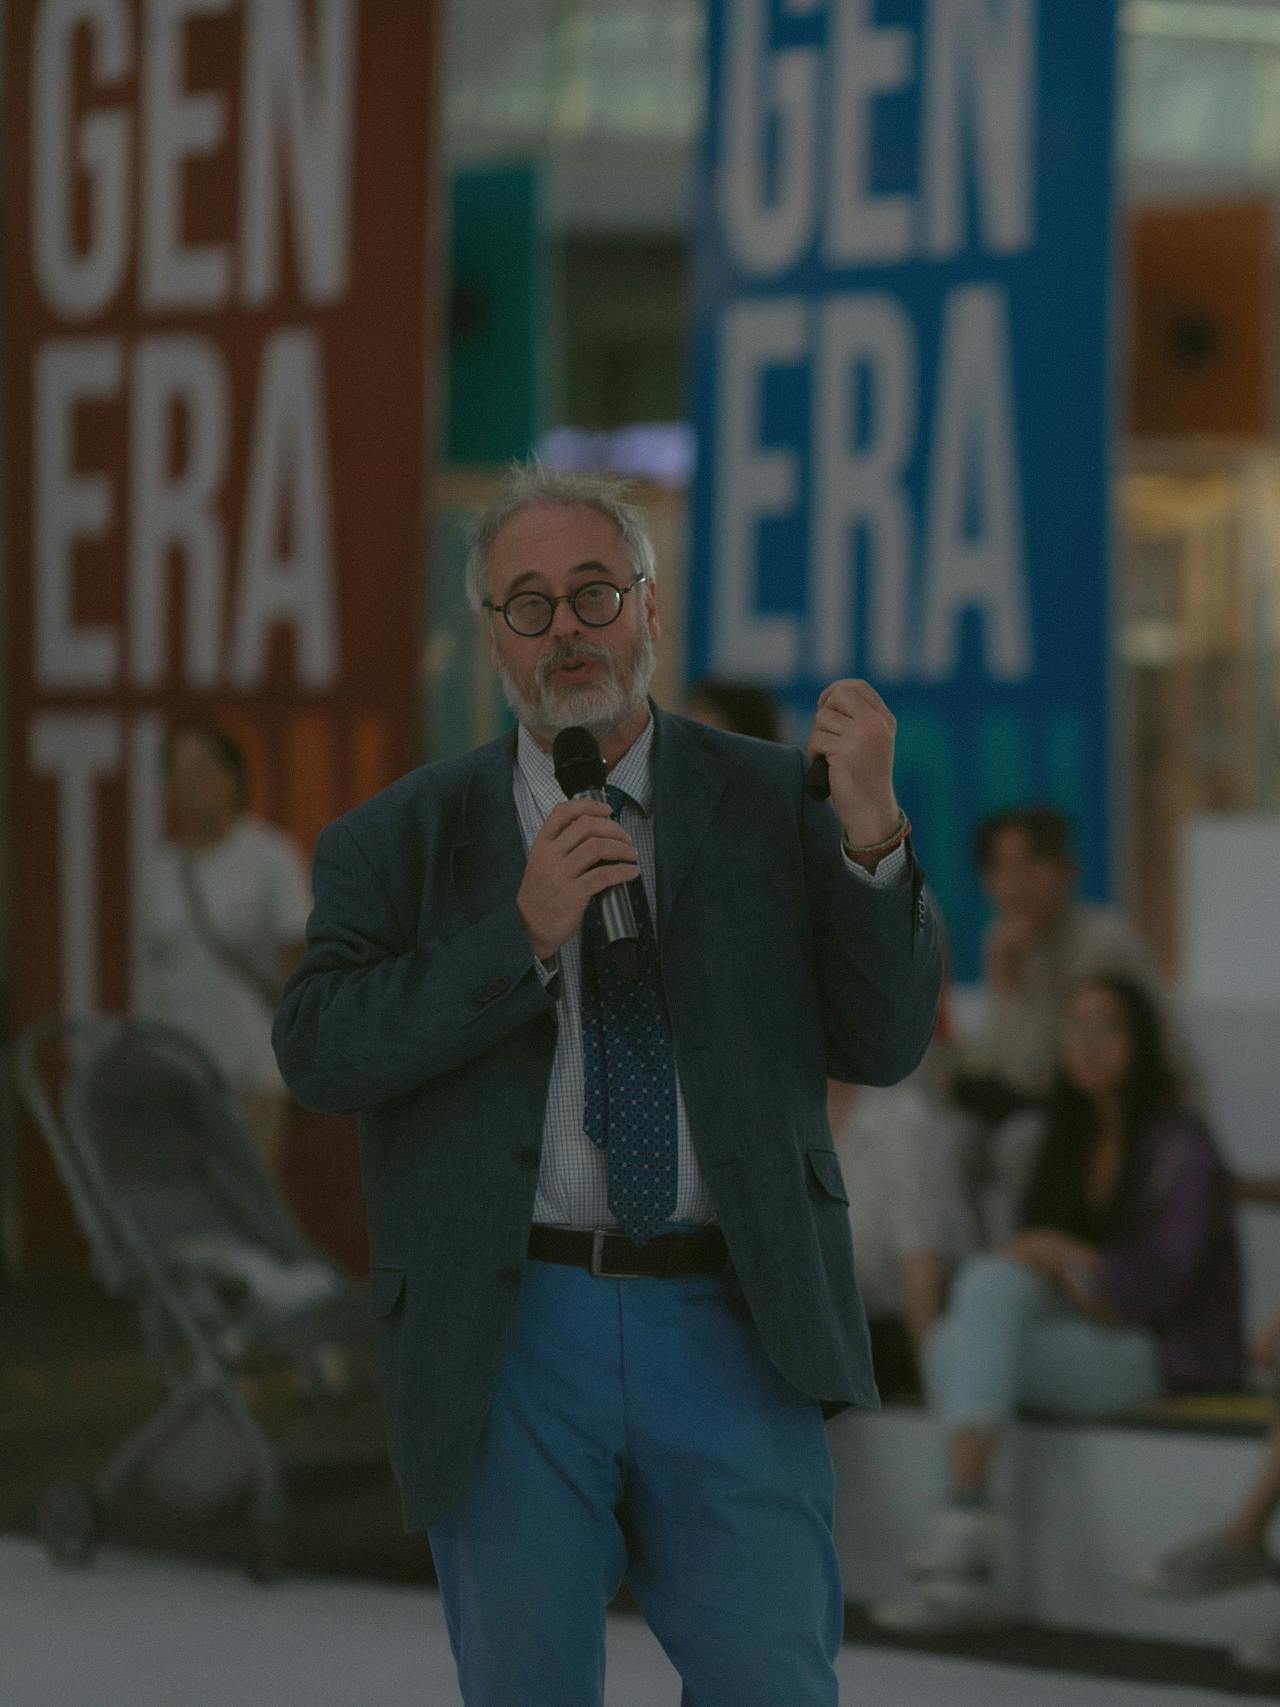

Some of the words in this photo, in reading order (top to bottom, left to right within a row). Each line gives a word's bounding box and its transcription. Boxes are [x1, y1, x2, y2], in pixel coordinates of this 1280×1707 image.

[31, 0, 358, 319] GEN
[718, 0, 1039, 279] GEN
[32, 326, 341, 695] ERA
[705, 282, 1036, 684] ERA
